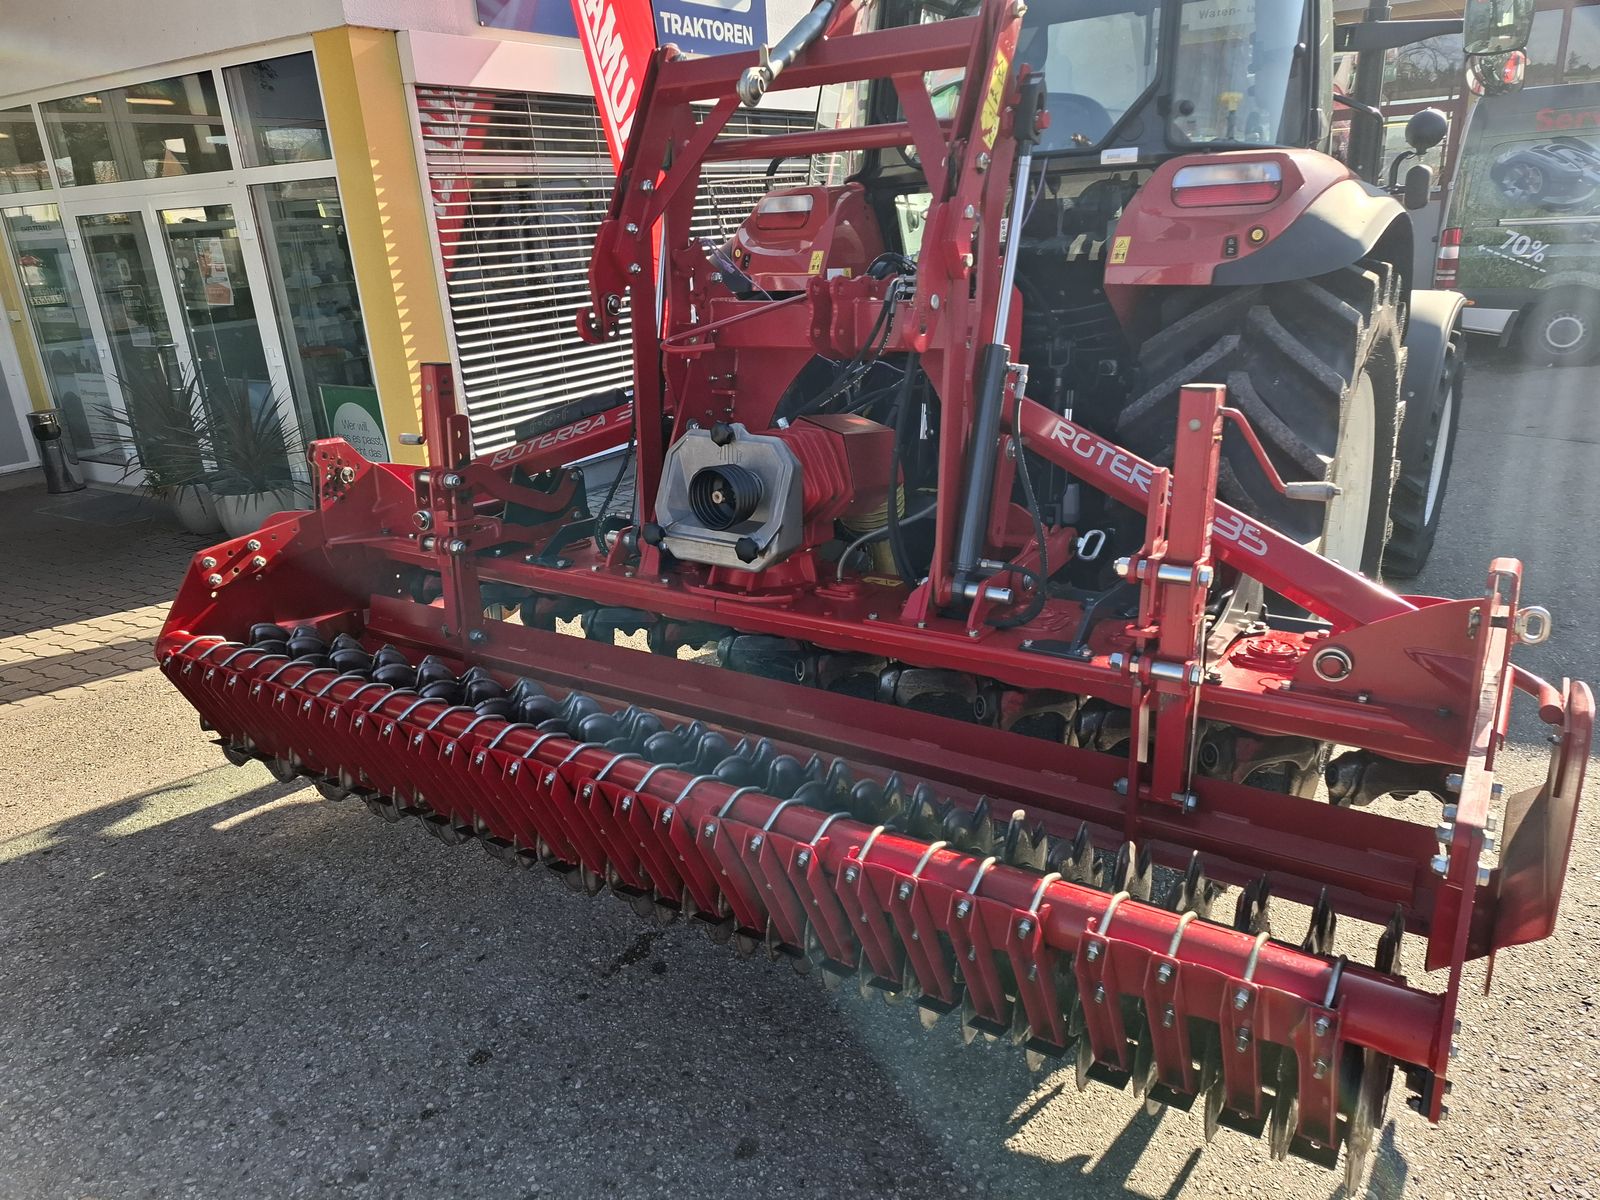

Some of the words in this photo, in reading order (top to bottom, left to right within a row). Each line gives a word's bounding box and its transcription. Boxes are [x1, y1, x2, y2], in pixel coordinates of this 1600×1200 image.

[660, 12, 753, 46] TRAKTOREN
[1500, 229, 1550, 263] 70%
[341, 419, 355, 431] Wer
[490, 414, 606, 467] ROTERRA
[1050, 420, 1174, 506] ROTER
[1212, 515, 1268, 556] 35
